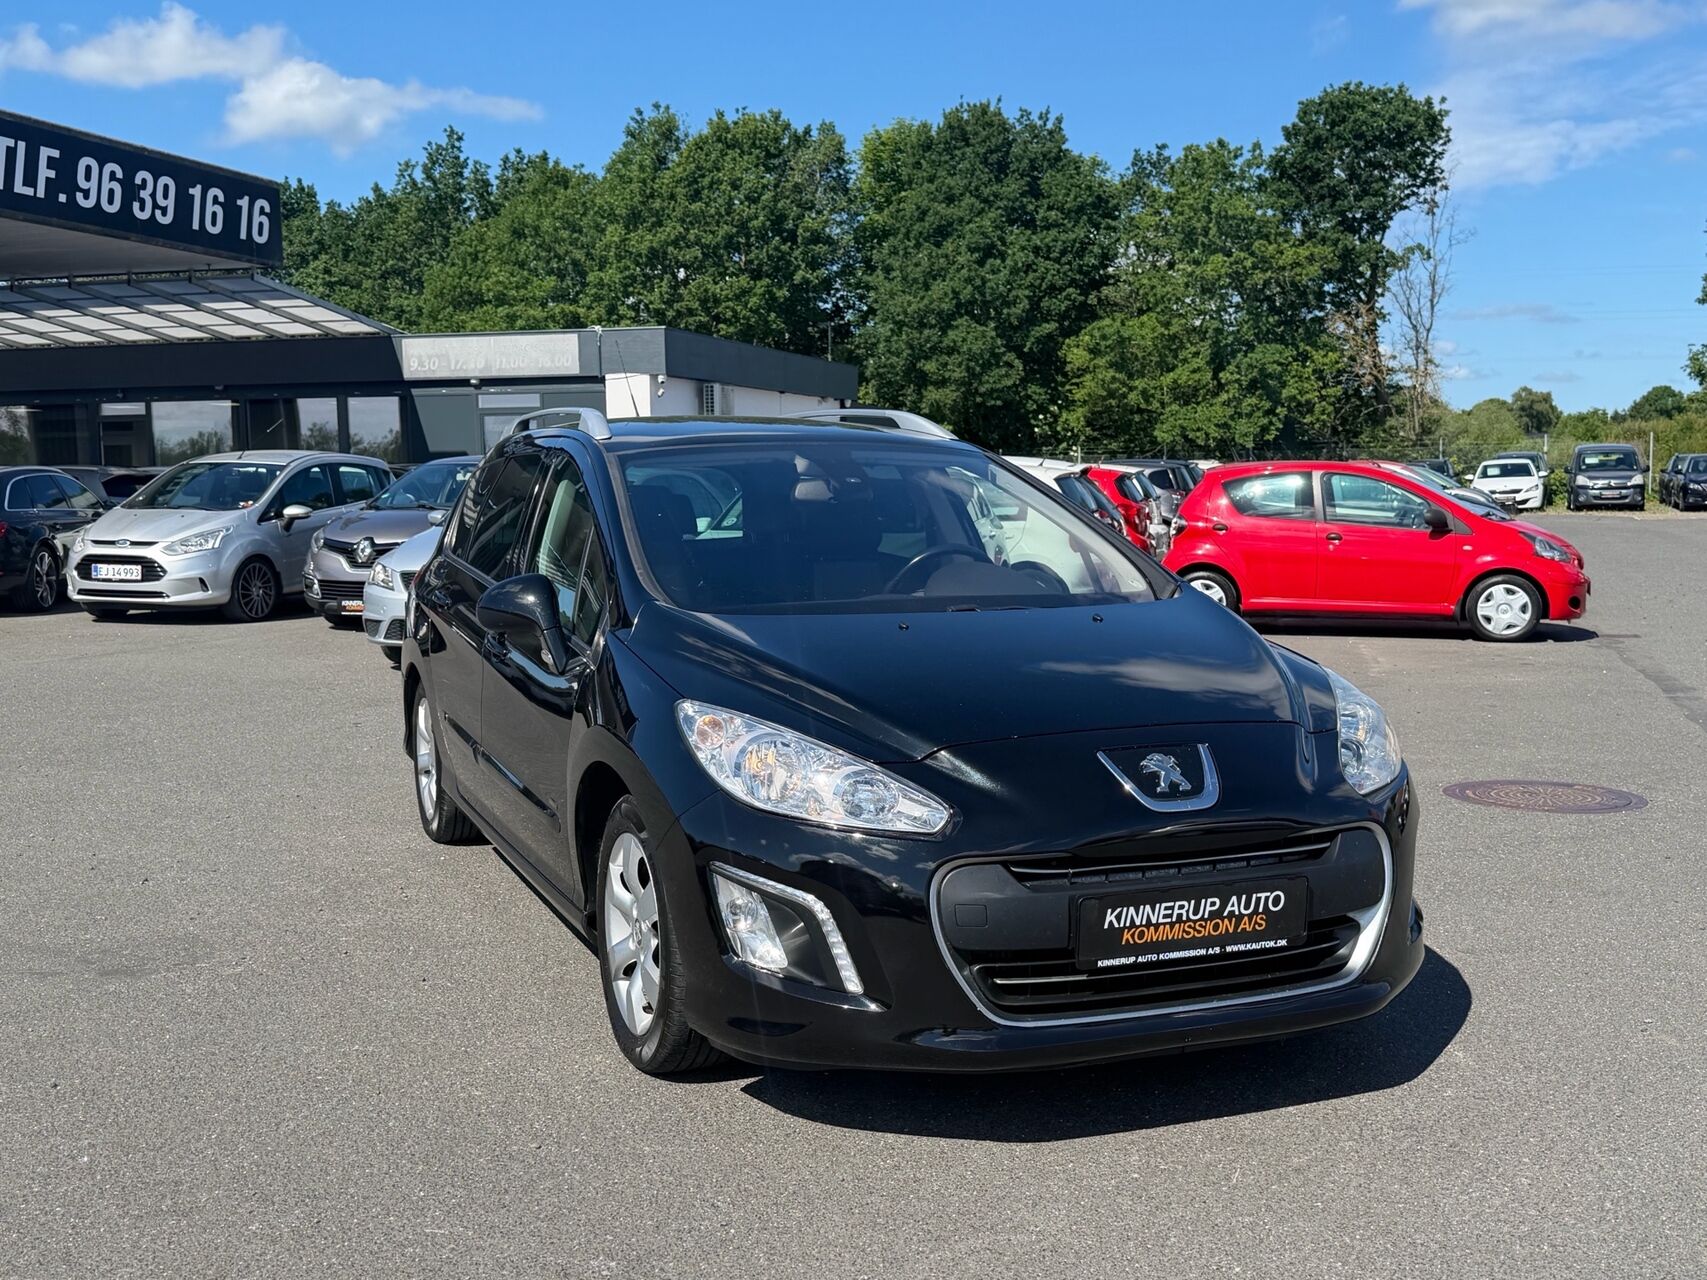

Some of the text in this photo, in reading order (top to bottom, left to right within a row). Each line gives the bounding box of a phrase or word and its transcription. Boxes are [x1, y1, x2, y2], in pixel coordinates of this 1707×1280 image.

[0, 135, 271, 245] TLF. 96 39 16 16
[409, 357, 439, 371] 9.30
[98, 566, 109, 577] EJ
[1103, 890, 1285, 929] KINNERUP AUTO
[1121, 915, 1267, 945] KOMMISSION A/S
[1097, 956, 1136, 968] KINNERUP
[1137, 953, 1158, 963] AUTO
[1159, 948, 1207, 960] KOMMISSION
[1207, 946, 1220, 956] A/S
[1225, 938, 1288, 953] WWW.KAUTOK.DK
